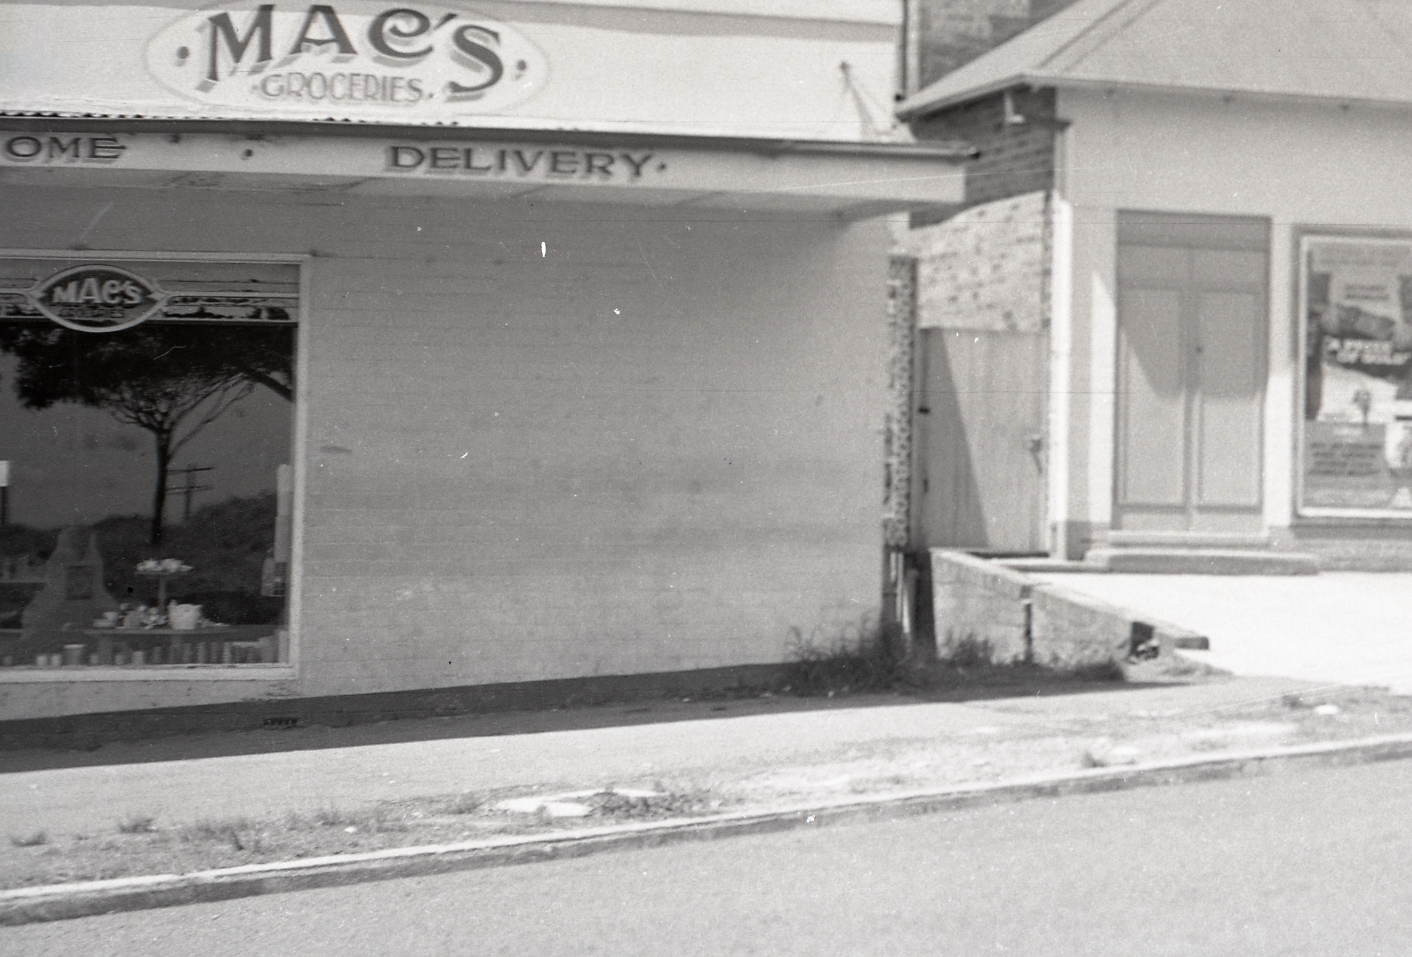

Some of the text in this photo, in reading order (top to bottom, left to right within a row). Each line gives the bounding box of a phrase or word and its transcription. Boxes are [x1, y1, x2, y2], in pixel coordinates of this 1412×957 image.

[208, 4, 504, 93] MAC'S
[260, 71, 424, 104] GROCERIES
[5, 135, 653, 176] OME DELIVERY
[52, 277, 142, 305] MAC'S
